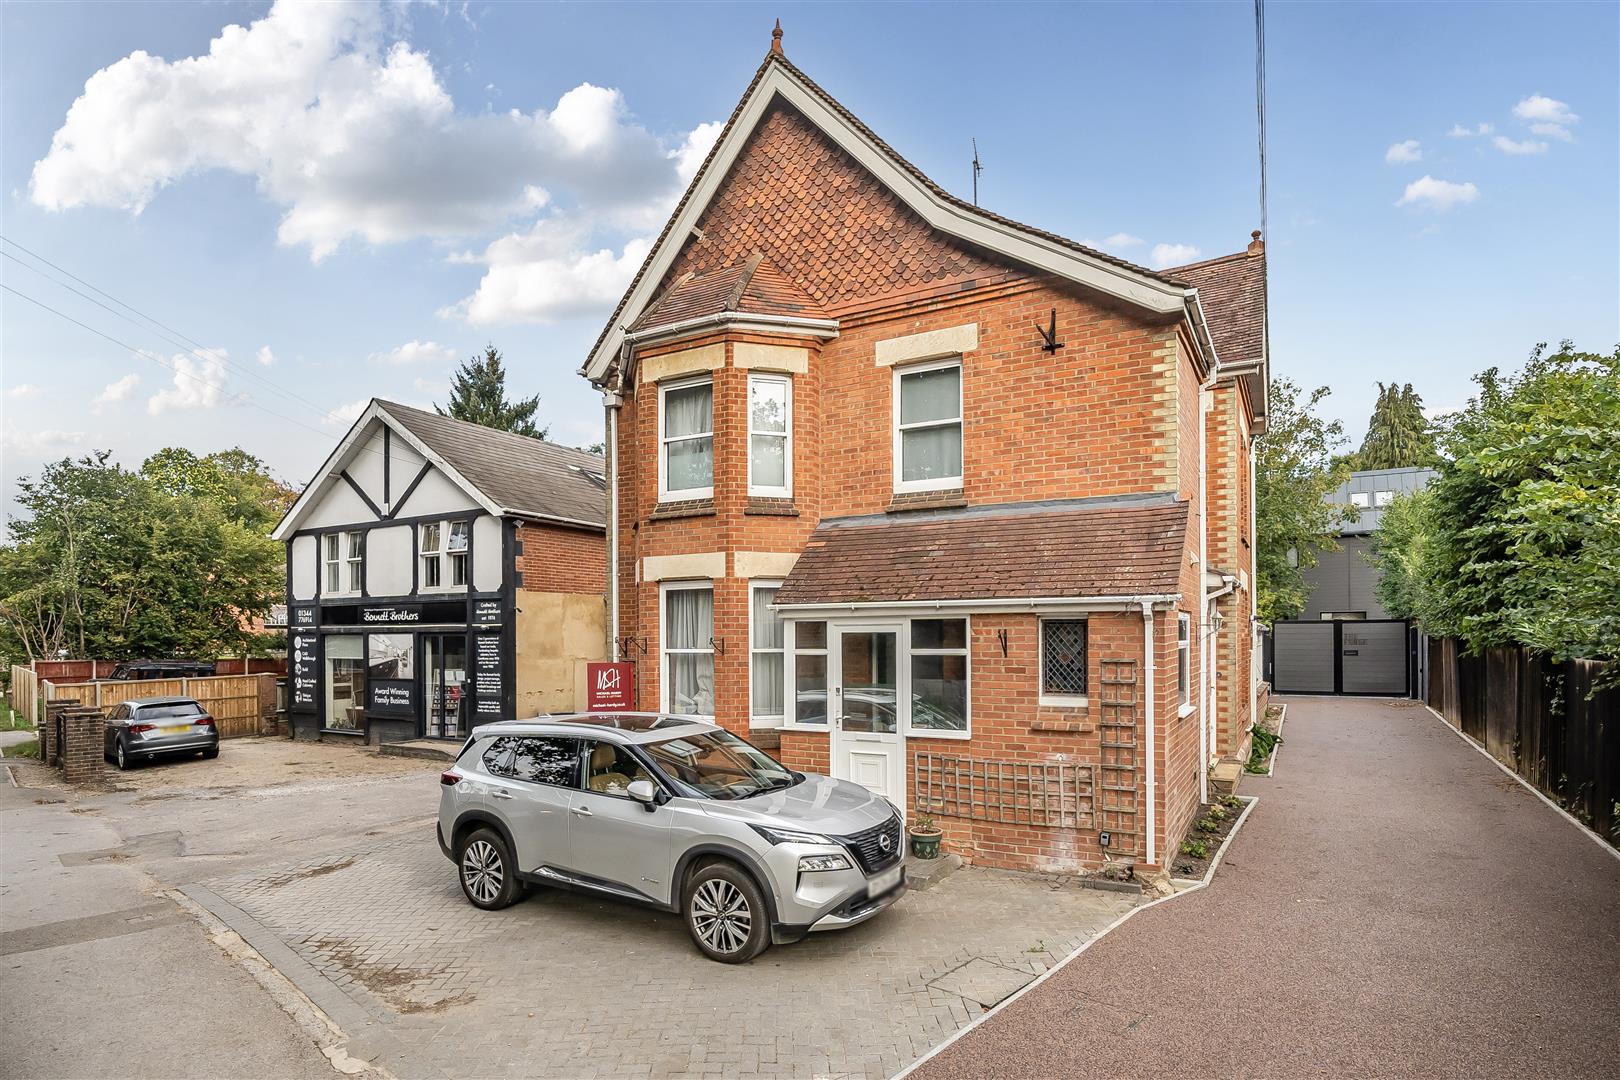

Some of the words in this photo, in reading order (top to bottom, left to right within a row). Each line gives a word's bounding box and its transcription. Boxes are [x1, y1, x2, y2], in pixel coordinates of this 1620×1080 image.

[390, 610, 418, 621] Brothers
[374, 686, 389, 695] Award
[390, 687, 409, 697] Winning
[374, 695, 389, 705] Family
[390, 696, 409, 705] Business
